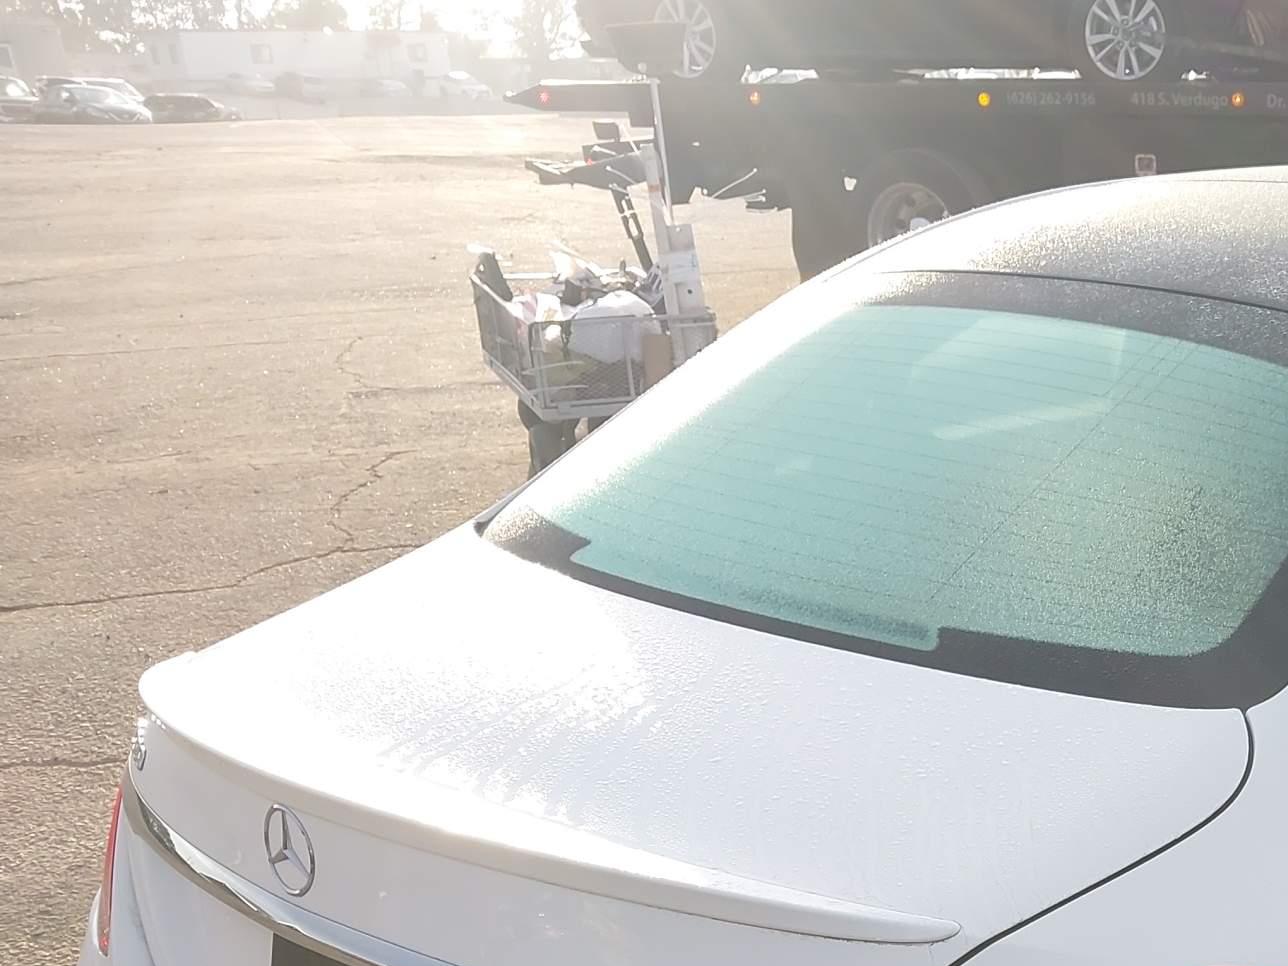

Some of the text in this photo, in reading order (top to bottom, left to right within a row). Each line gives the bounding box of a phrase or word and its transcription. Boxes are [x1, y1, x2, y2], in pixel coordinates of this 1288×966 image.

[1040, 91, 1096, 106] 262-9156
[1130, 91, 1155, 106] 418
[1158, 92, 1169, 106] S.
[1173, 91, 1229, 110] Verdugo
[1266, 93, 1286, 108] Dr.
